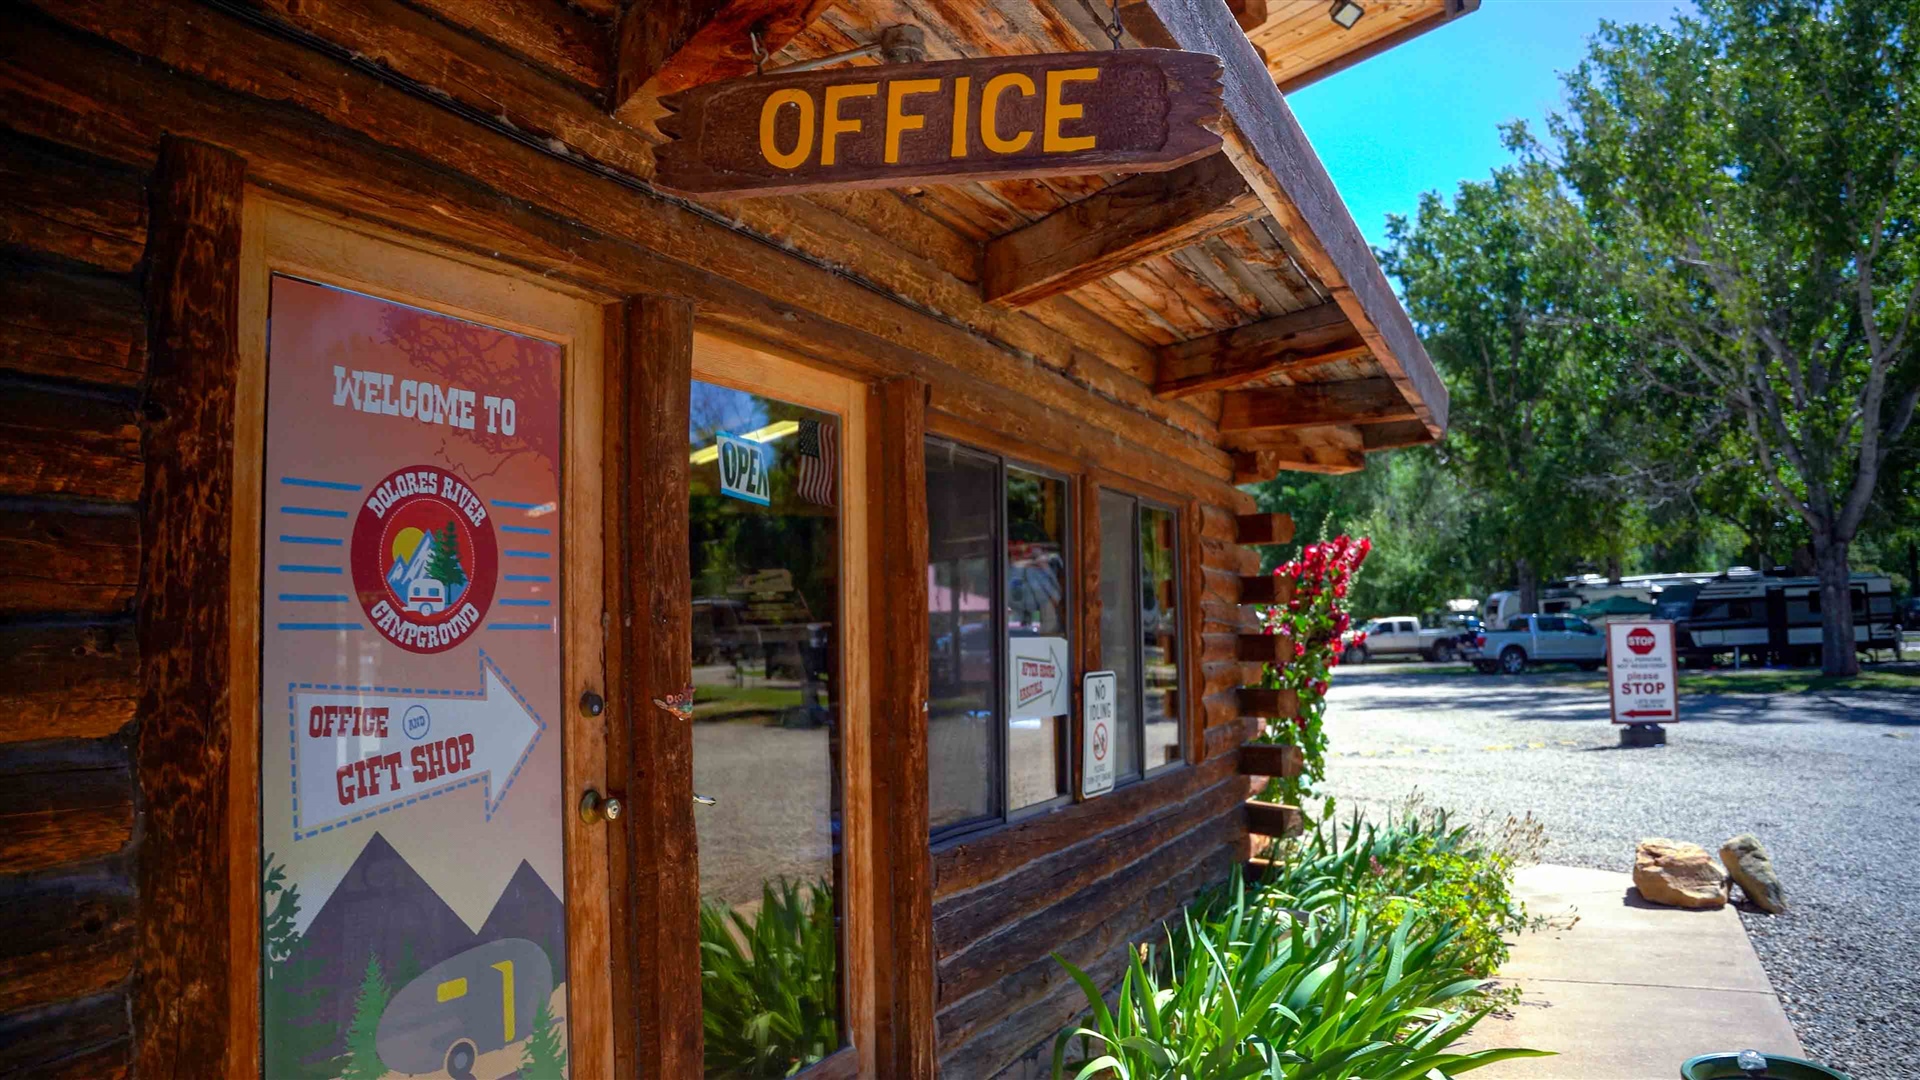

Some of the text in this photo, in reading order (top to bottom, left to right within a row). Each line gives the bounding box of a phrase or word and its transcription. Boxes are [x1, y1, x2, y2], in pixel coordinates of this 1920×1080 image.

[759, 67, 1100, 170] OFFICE
[333, 365, 516, 436] WELCOME TO
[722, 441, 768, 498] OPEN
[366, 471, 487, 527] DOLORES RIVER
[371, 599, 480, 649] CAMPGROUND
[1627, 636, 1655, 646] STOP
[1095, 684, 1106, 700] NO
[1621, 682, 1665, 695] STOP
[1627, 672, 1660, 681] please
[308, 705, 426, 738] OFFICE AND
[336, 733, 475, 806] GIFT SHOP
